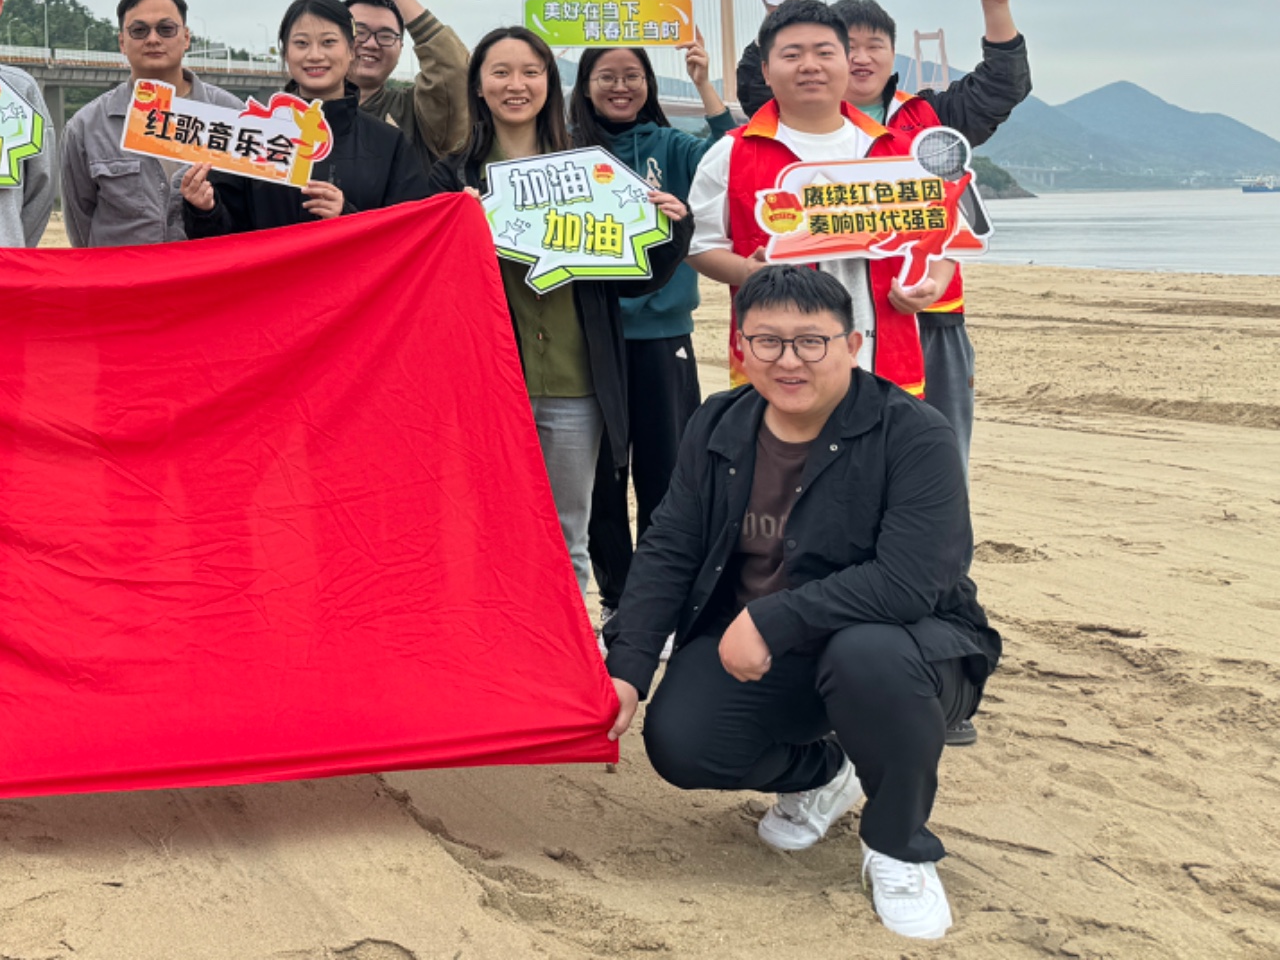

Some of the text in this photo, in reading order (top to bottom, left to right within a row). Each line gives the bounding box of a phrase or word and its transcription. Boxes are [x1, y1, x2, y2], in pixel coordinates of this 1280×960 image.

[543, 0, 640, 22] 美好在当下
[583, 20, 680, 42] 青春正当时
[144, 109, 295, 165] 红歌音乐会
[509, 161, 593, 211] 加油
[803, 179, 943, 208] 赓续红色基因
[542, 208, 624, 258] 加油
[809, 207, 946, 236] 奏响时代强音
